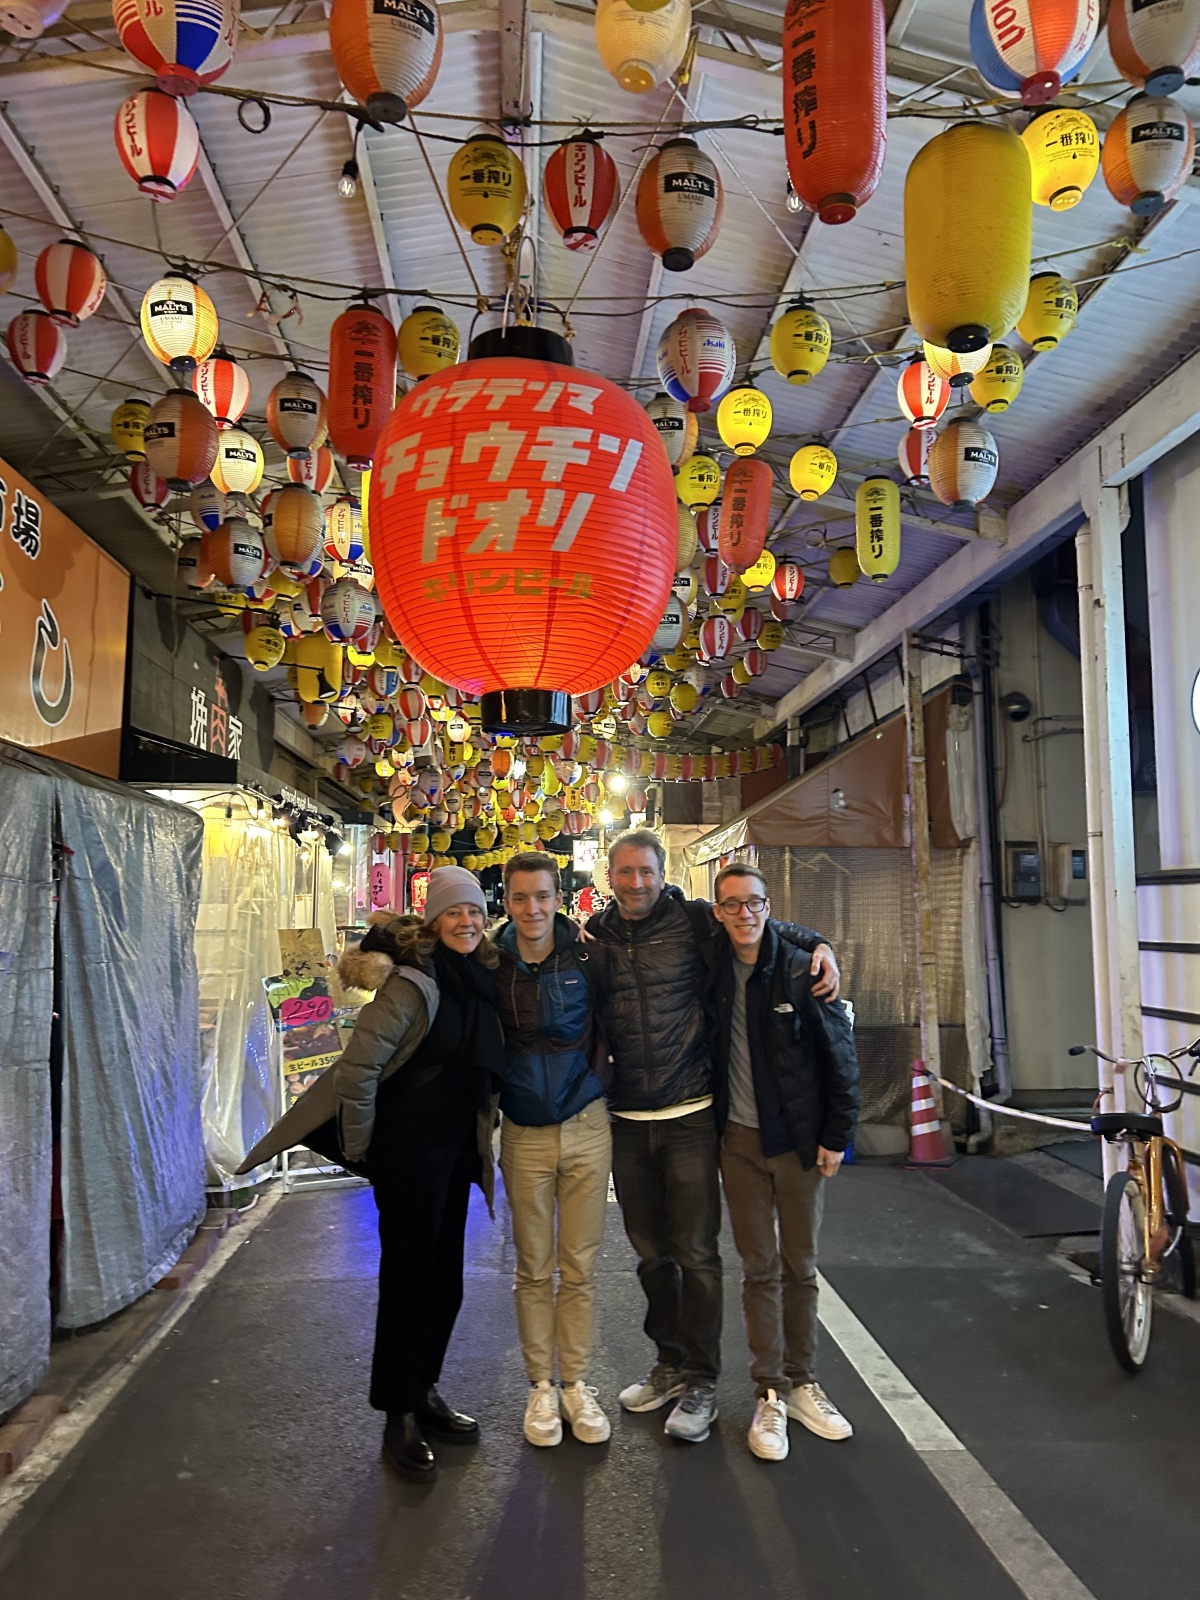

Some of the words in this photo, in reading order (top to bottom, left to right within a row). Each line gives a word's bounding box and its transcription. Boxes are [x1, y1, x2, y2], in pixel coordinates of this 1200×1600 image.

[1045, 131, 1095, 148] 一番搾り
[459, 168, 512, 187] 一番搾り
[352, 350, 375, 430] 一番搾り
[379, 421, 644, 499] チョウチン
[421, 488, 596, 564] ドオリ
[868, 506, 884, 559] 一番搾り
